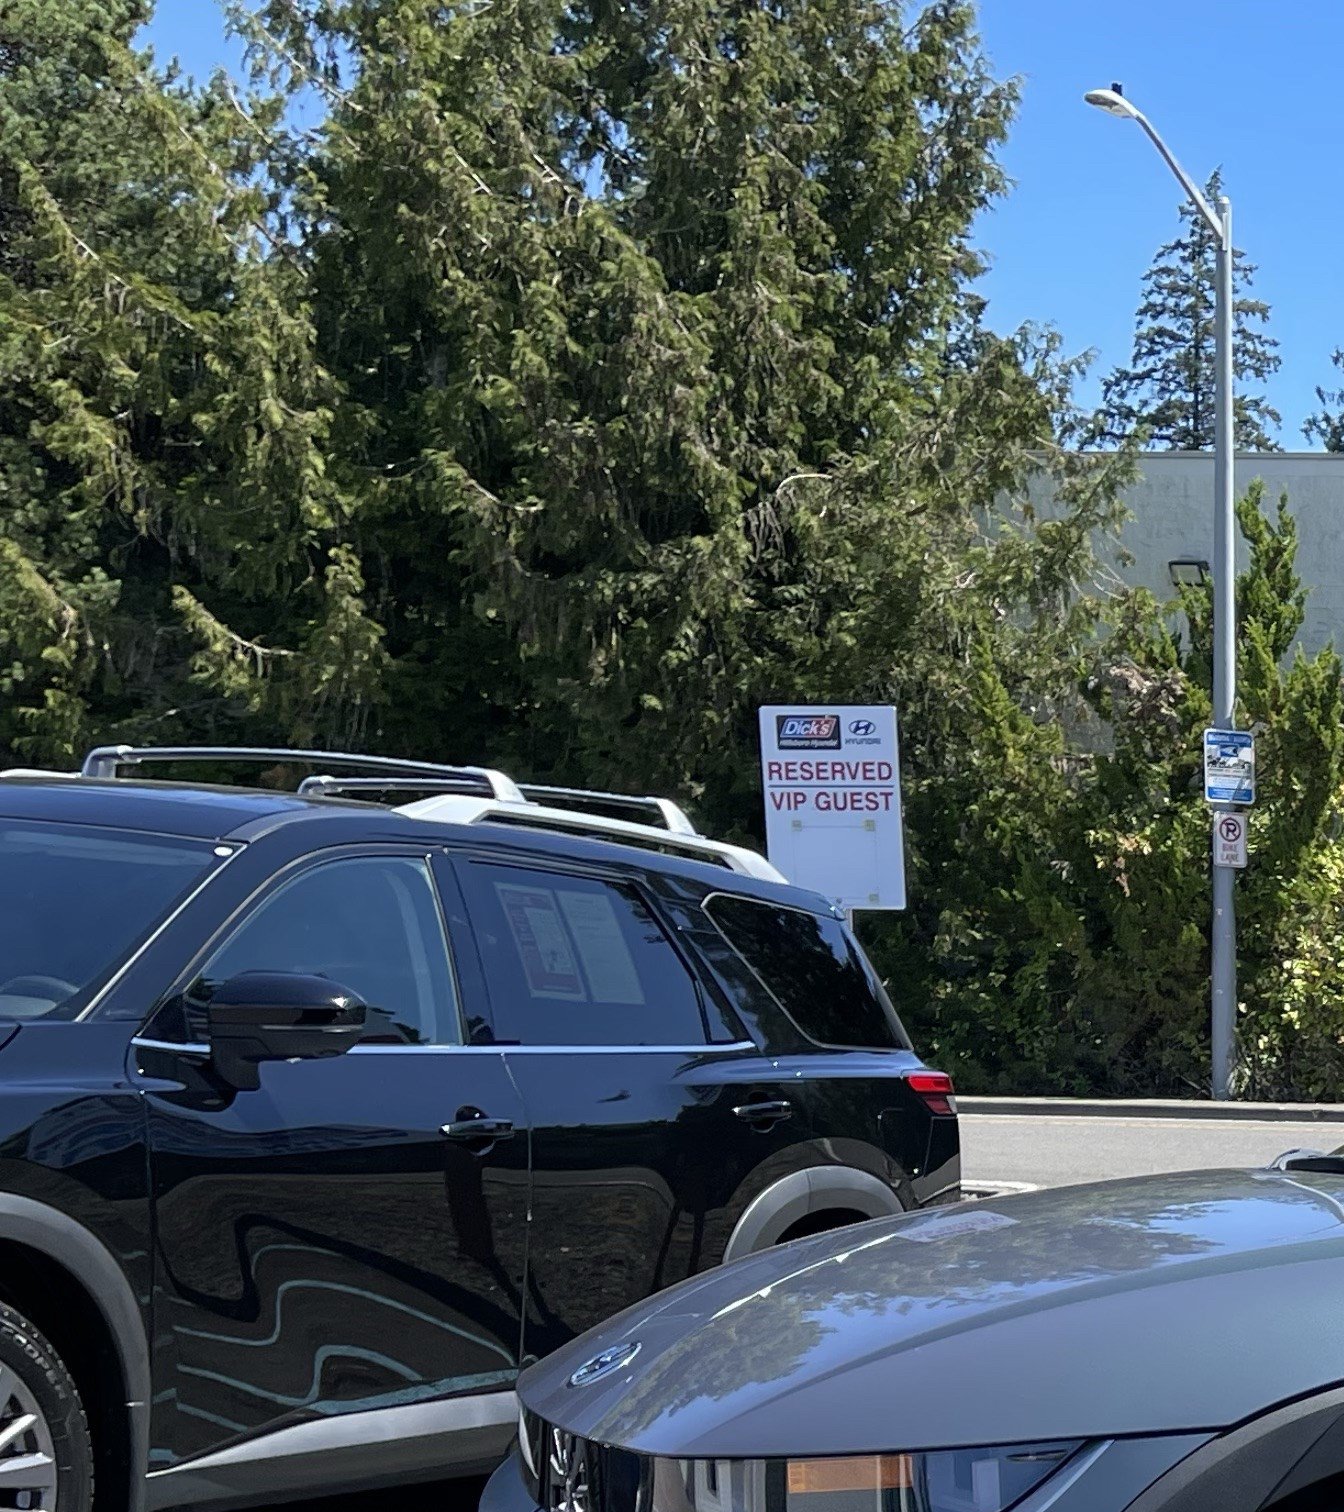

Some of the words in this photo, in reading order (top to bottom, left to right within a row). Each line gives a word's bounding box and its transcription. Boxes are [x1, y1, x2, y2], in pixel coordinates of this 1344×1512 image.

[784, 720, 830, 736] Dick's
[844, 737, 882, 745] HYUNDAI
[767, 761, 893, 781] RESERVED
[769, 791, 807, 811] VIP
[814, 791, 894, 811] GUEST
